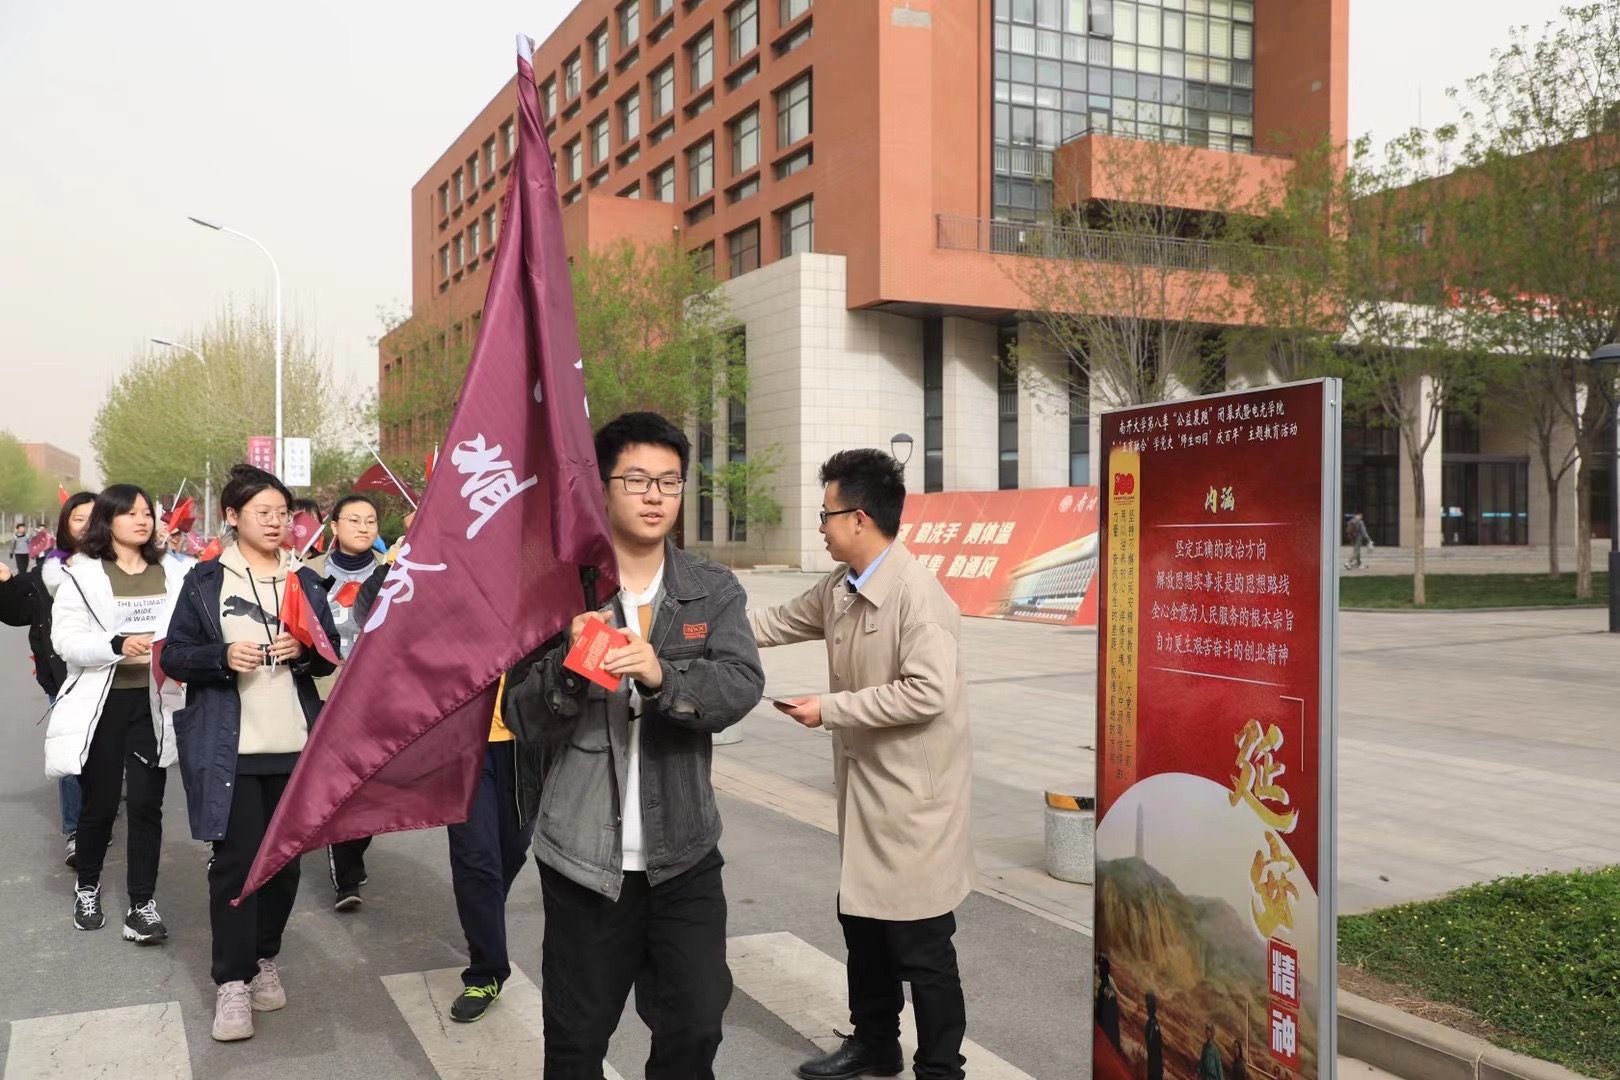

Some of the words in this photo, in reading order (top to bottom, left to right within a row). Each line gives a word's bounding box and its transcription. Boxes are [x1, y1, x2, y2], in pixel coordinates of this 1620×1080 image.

[1174, 538, 1267, 560] 坚定正确的政治方向
[1155, 570, 1290, 596] 解放思想实事求是的思想路线
[1151, 600, 1294, 632] 全心全意为人民服务的根本宗旨
[1156, 632, 1289, 666] 自力更生艰苦奋斗的创业精神
[1272, 949, 1297, 1058] 精神
